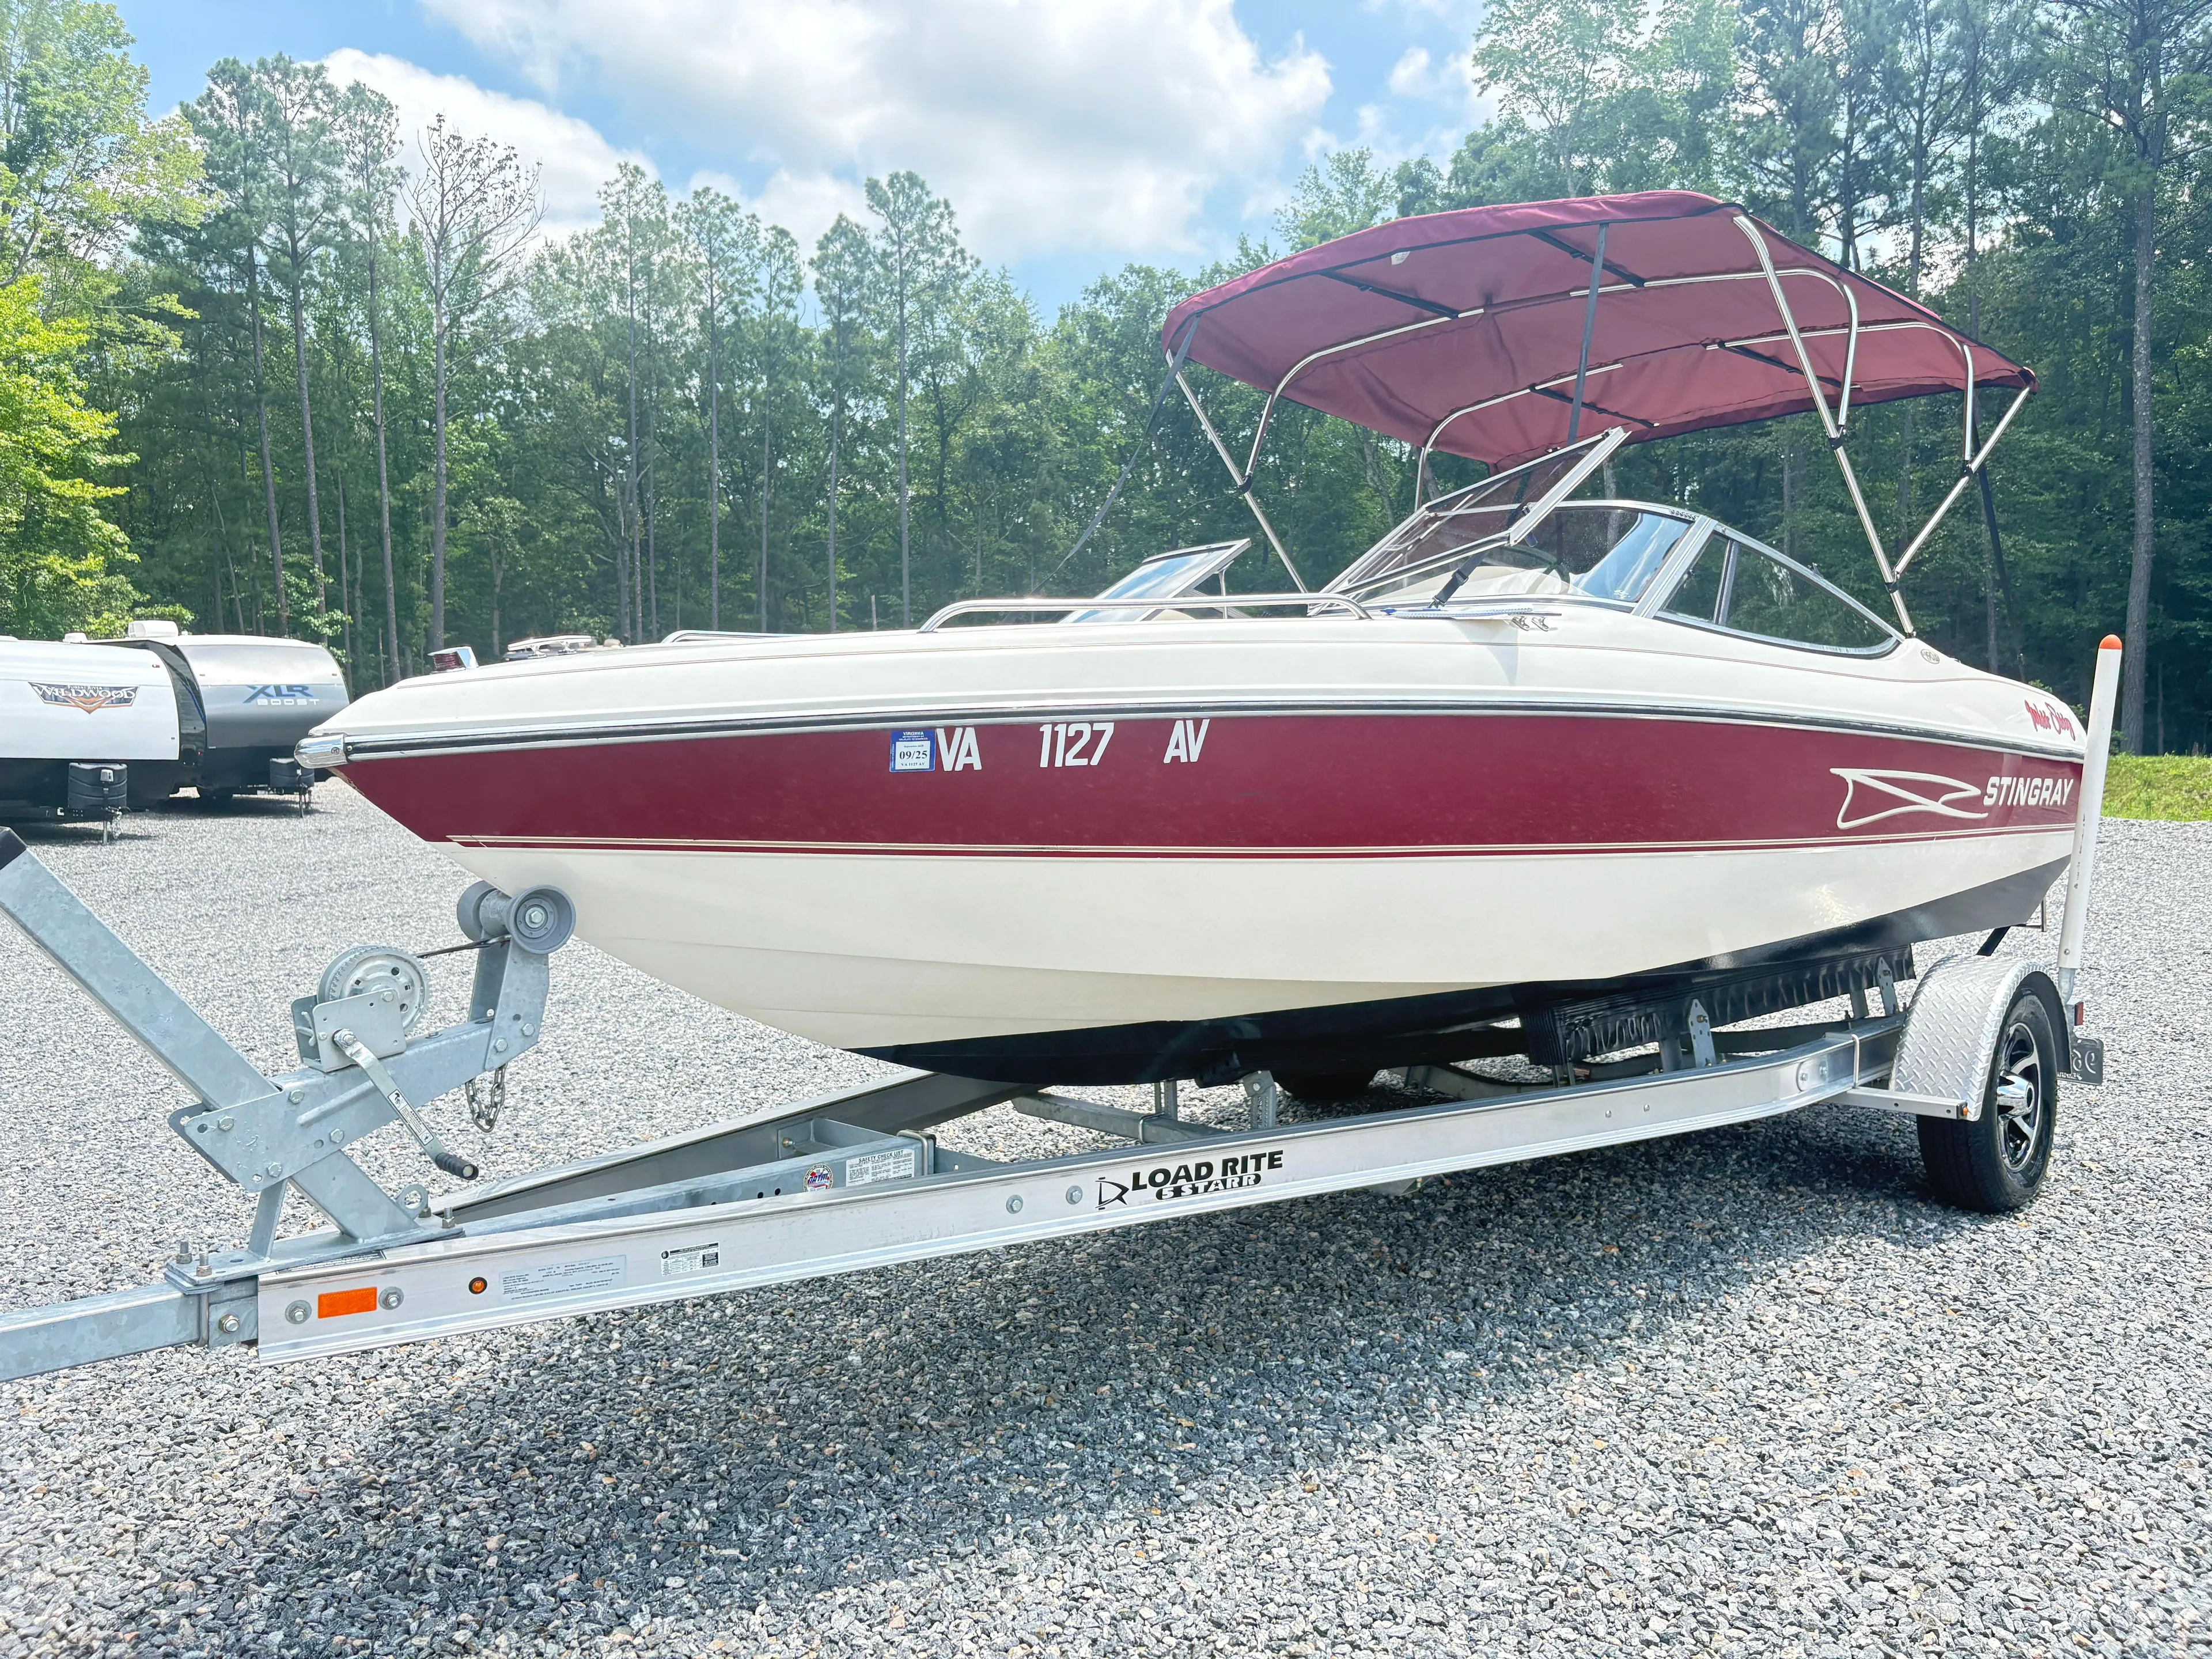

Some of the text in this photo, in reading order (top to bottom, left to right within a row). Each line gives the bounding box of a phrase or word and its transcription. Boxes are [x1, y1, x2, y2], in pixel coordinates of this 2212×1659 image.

[31, 683, 136, 699] WILDWOOD
[243, 685, 313, 703] XLR
[899, 750, 927, 759] 09/25
[936, 727, 982, 771] VA
[1039, 722, 1114, 767] 1127
[1164, 718, 1210, 764] AV
[1983, 777, 2073, 806] STINGRAY
[859, 1155, 876, 1164] SAFETY
[1131, 1150, 1283, 1191] LOAD RITE
[1161, 1175, 1256, 1199] 5 STARR
